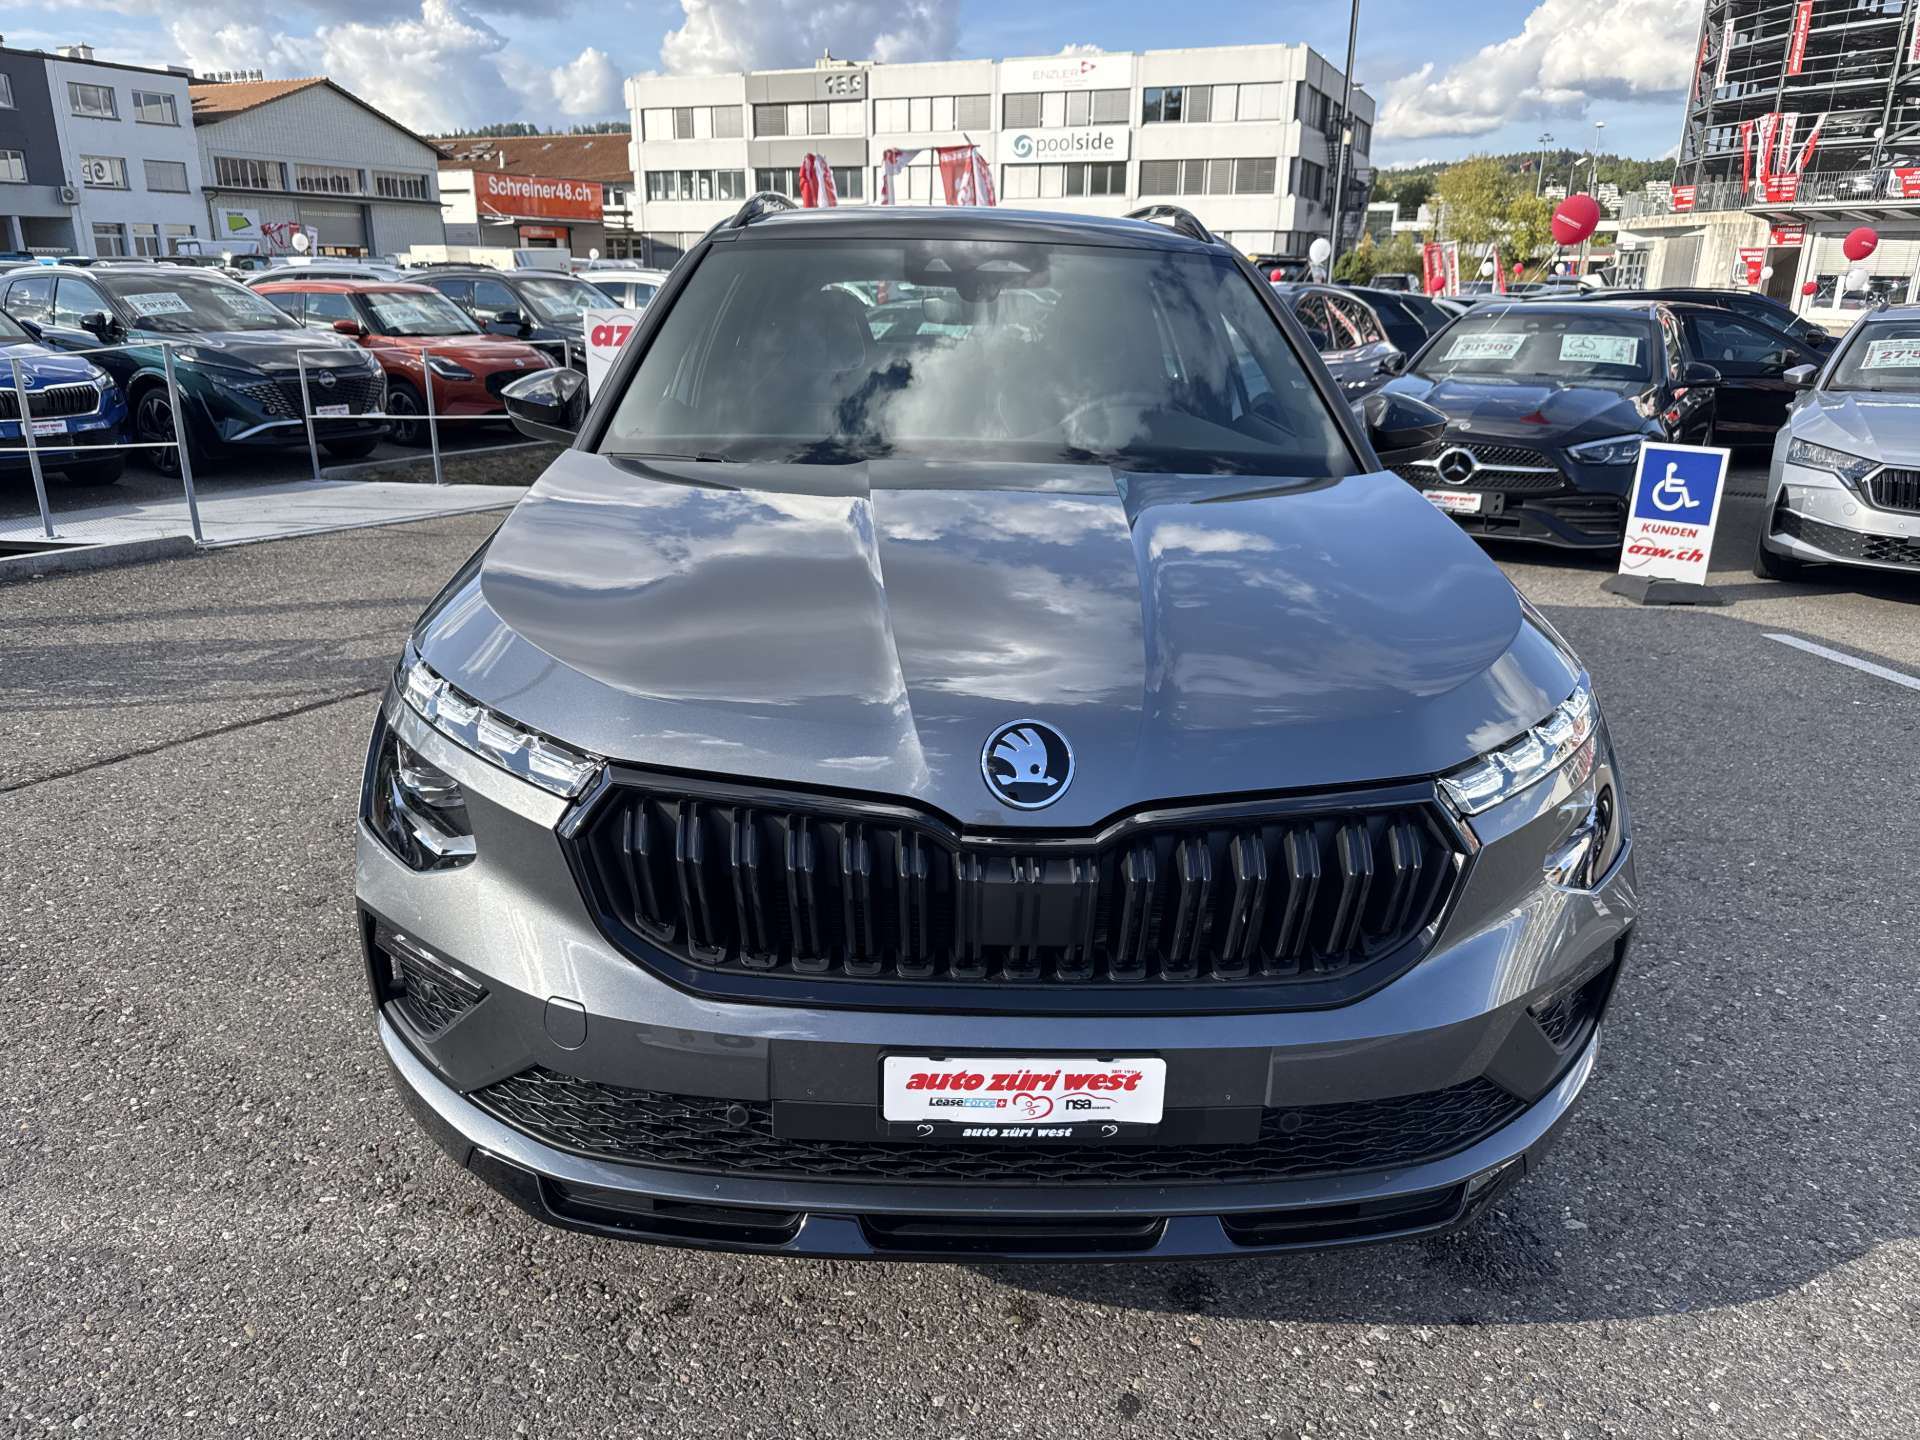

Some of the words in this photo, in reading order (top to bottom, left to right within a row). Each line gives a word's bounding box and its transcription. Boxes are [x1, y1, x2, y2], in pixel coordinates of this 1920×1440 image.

[1033, 69, 1078, 80] ENZLER
[1036, 132, 1114, 159] poolside
[489, 175, 592, 201] Schreiner48.ch
[1641, 523, 1699, 538] KUNDEN
[1628, 544, 1704, 563] azw.ch
[905, 1070, 985, 1091] auto
[986, 1069, 1062, 1091] züri
[1063, 1071, 1143, 1091] west
[928, 1097, 996, 1109] LeaseForce
[1065, 1099, 1091, 1110] nsa
[962, 1127, 998, 1138] auto
[1000, 1126, 1035, 1138] züri
[1037, 1127, 1073, 1138] west
